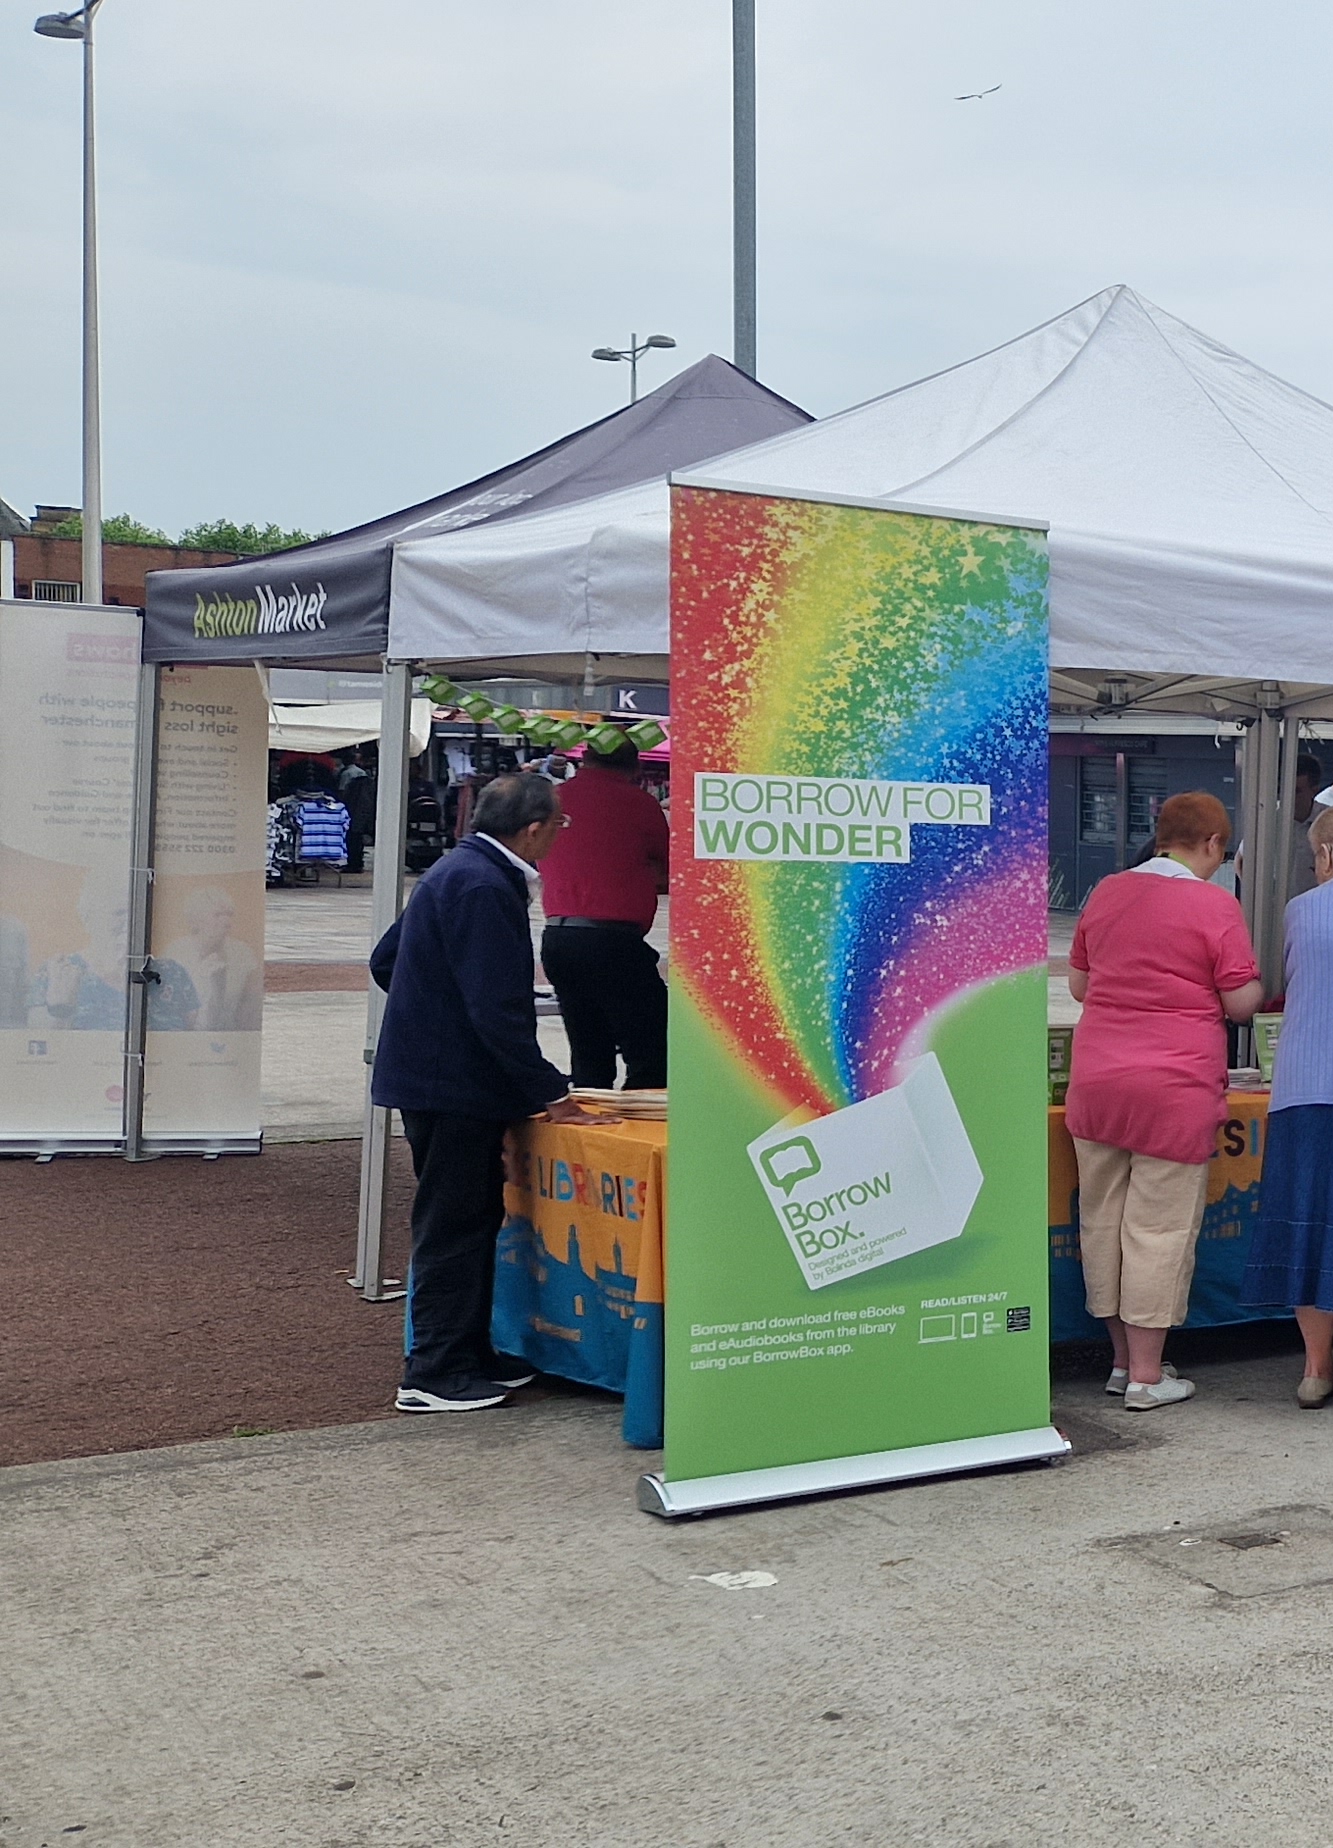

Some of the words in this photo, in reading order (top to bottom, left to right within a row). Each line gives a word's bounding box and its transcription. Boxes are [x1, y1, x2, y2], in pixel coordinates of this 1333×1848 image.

[619, 690, 637, 709] K
[700, 777, 894, 818] BORROW
[902, 787, 984, 821] FOR
[699, 818, 904, 858] WONDER
[781, 1171, 892, 1231] Borrow
[794, 1220, 865, 1259] Box.
[807, 1249, 850, 1271] Designed
[851, 1242, 868, 1255] and
[869, 1227, 907, 1249] powered
[812, 1270, 825, 1281] by
[857, 1247, 884, 1262] digital
[920, 1294, 986, 1309] READ/LISTEN
[987, 1291, 1008, 1303] 24/7
[690, 1323, 740, 1337] Borrow
[741, 1317, 767, 1332] and
[768, 1311, 832, 1329] download
[833, 1309, 857, 1322] free
[859, 1304, 906, 1320] eBooks
[690, 1339, 716, 1354] and
[718, 1330, 804, 1350] eAudiobooks
[806, 1327, 835, 1341] from
[837, 1325, 857, 1338] the
[858, 1321, 897, 1337] library
[690, 1356, 727, 1371] using
[728, 1354, 752, 1366] our
[752, 1345, 825, 1364] BorrowBox
[826, 1342, 855, 1357] app.
